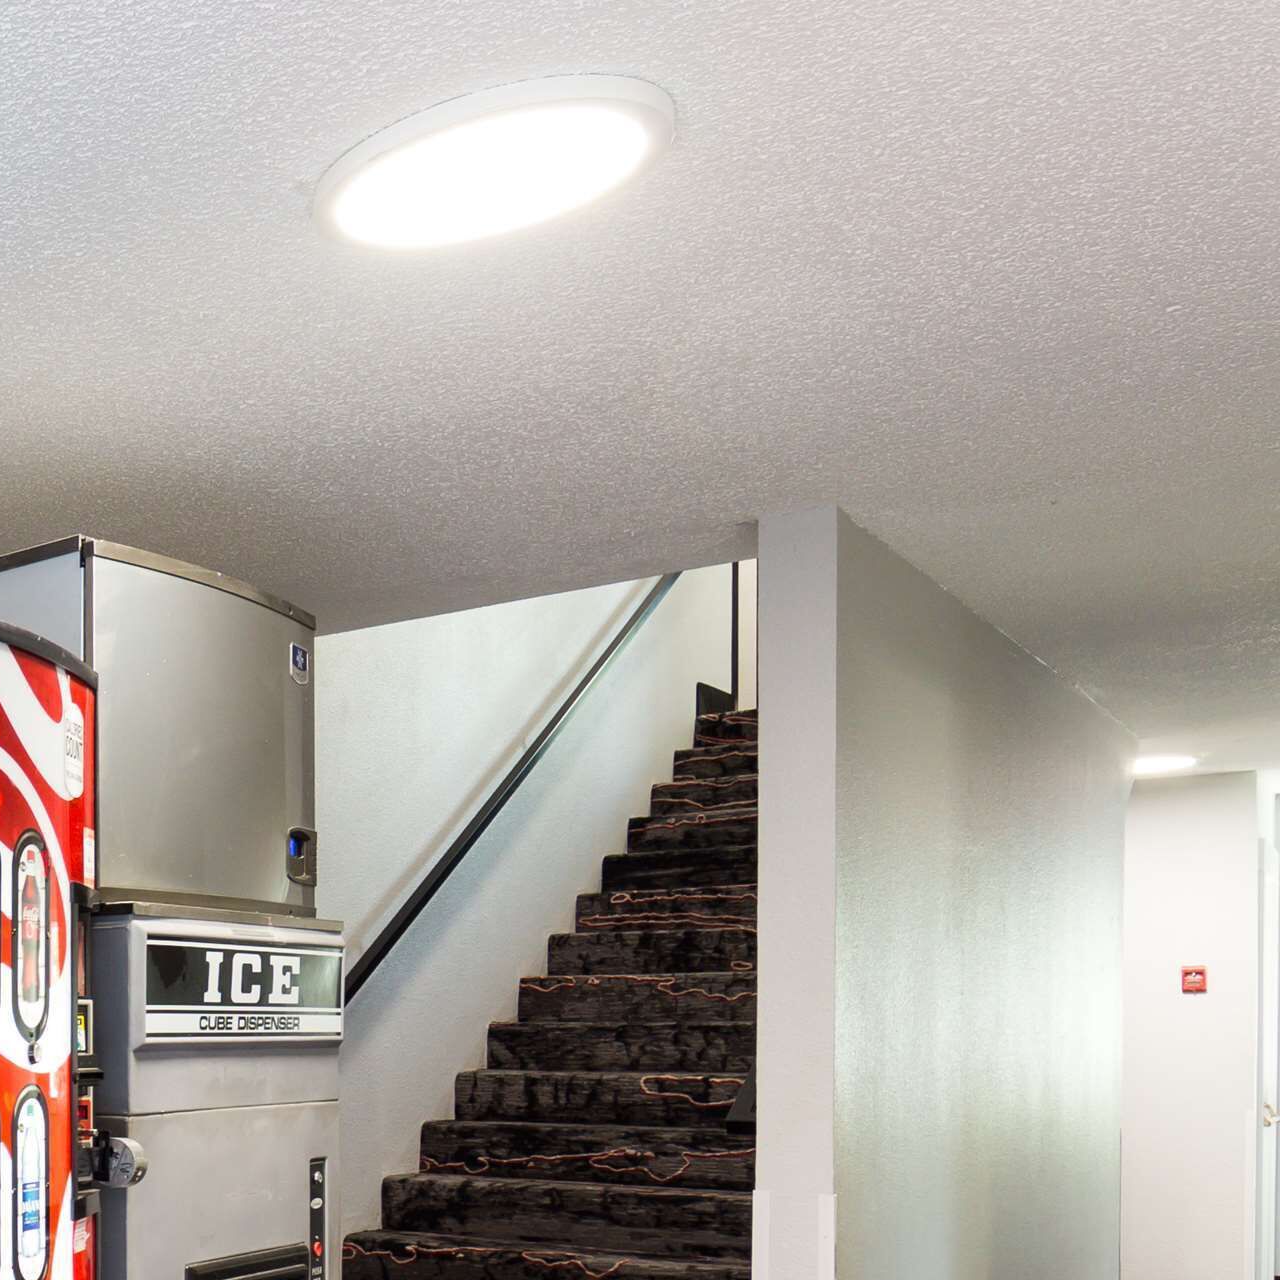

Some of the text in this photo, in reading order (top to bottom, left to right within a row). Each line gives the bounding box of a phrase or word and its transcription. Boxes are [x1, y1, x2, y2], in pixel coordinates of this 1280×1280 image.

[65, 735, 84, 759] COUNT
[203, 951, 302, 1004] ICE
[199, 1015, 301, 1031] CUBE DISPENSER
[312, 1265, 323, 1276] PUSH
